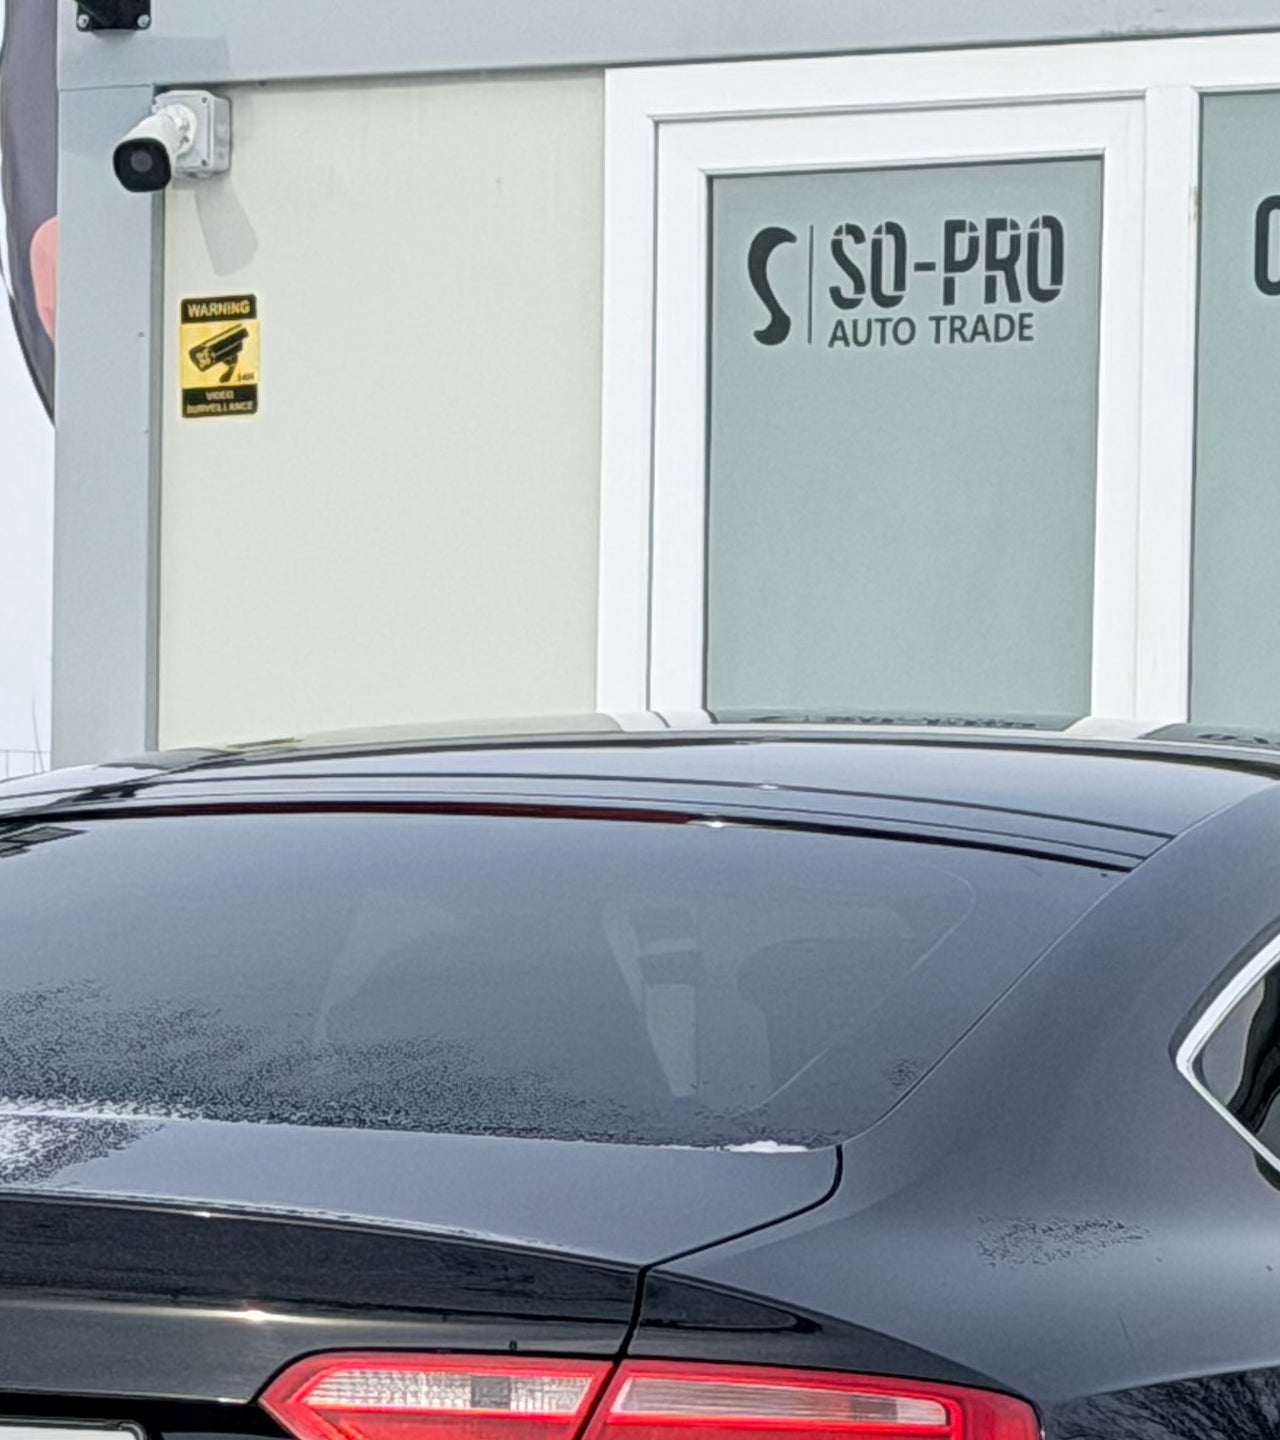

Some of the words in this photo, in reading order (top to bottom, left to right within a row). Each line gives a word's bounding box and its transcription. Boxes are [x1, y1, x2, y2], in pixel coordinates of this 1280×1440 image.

[828, 215, 1064, 310] SO-PRO
[187, 300, 251, 318] WARNING
[828, 317, 916, 348] AUTO
[929, 312, 1035, 344] TRADE
